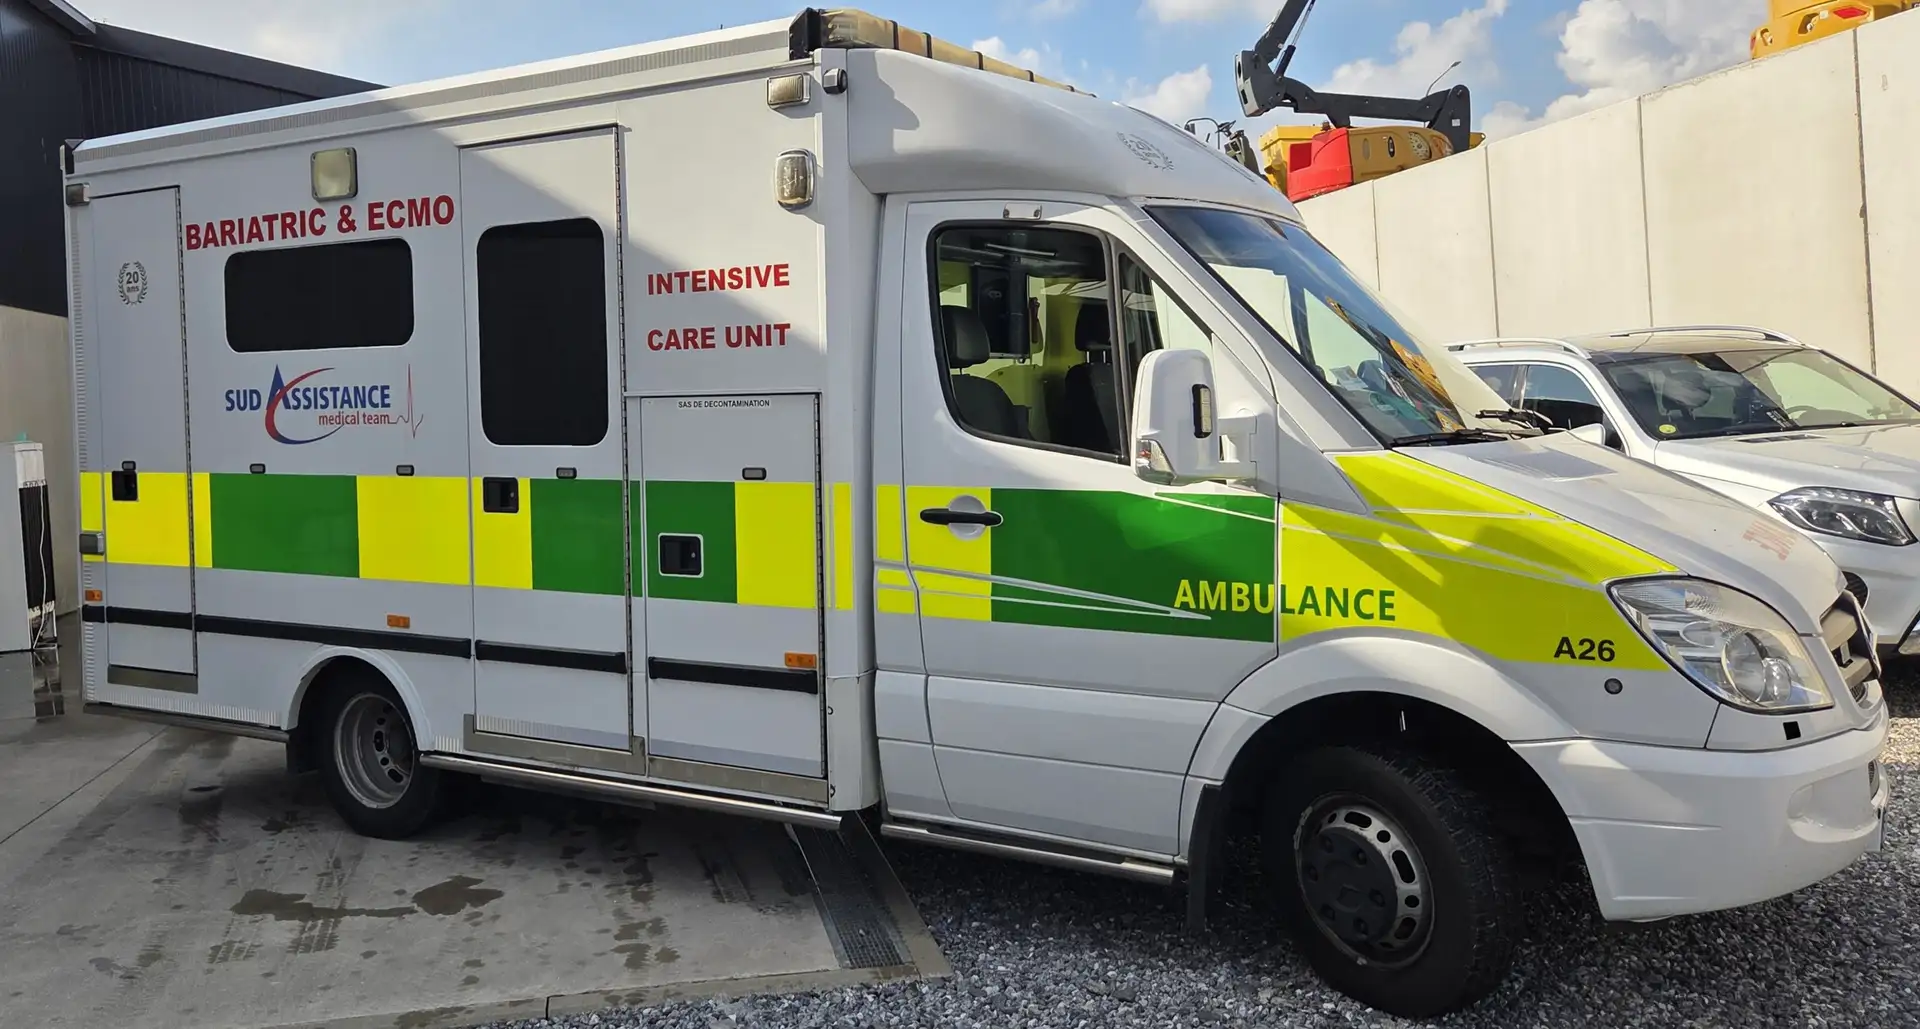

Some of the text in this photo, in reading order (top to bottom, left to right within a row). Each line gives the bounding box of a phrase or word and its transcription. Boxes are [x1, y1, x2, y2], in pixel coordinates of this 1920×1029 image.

[186, 195, 455, 250] BARIATRIC & ECMO
[126, 271, 140, 284] 20
[647, 263, 790, 295] INTENSIVE
[647, 323, 791, 351] CARE UNIT
[225, 364, 391, 412] SUD ASSISTANCE
[318, 411, 390, 426] medical team
[1173, 579, 1396, 621] AMBULANCE
[1553, 636, 1616, 662] A26
